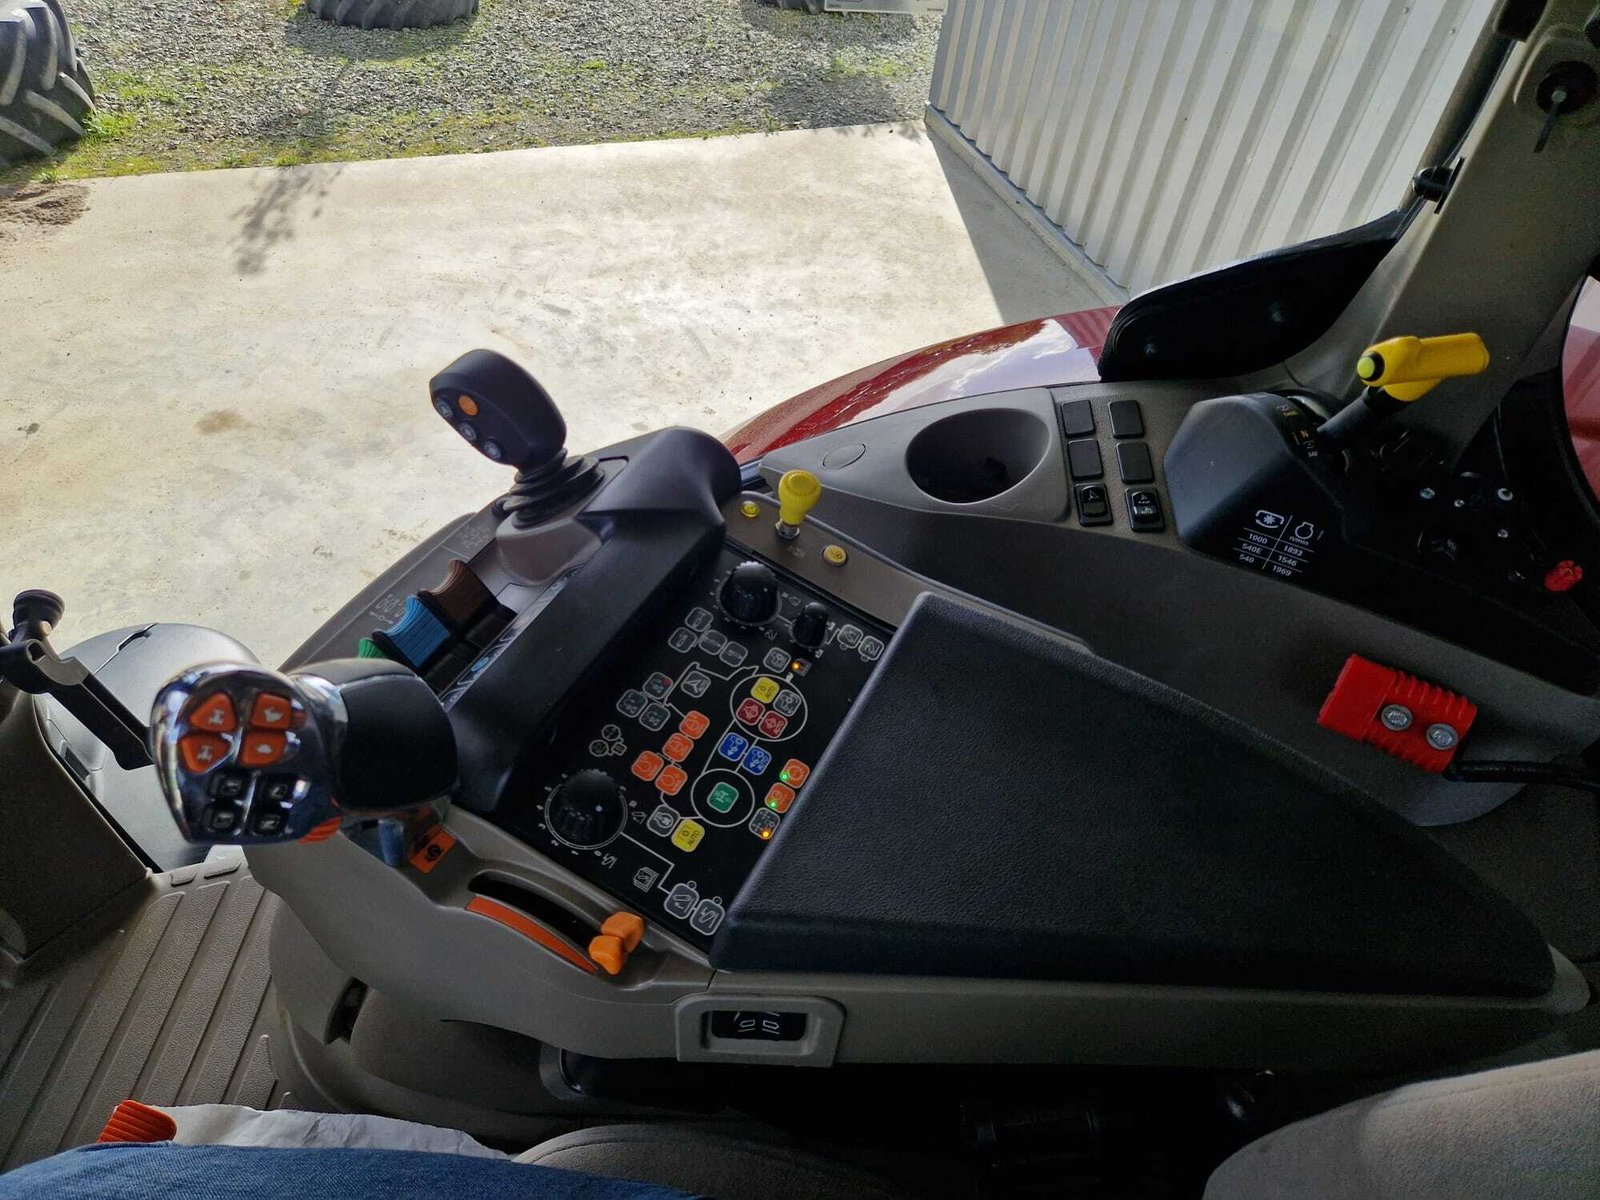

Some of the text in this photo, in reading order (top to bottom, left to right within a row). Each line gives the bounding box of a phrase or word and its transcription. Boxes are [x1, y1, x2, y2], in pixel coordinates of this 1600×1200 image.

[1249, 533, 1268, 544] 1000
[1242, 543, 1262, 554] 540E
[1283, 545, 1303, 556] 1893
[1239, 554, 1255, 563] 540
[1278, 555, 1298, 566] 1546
[1272, 565, 1292, 576] 1969
